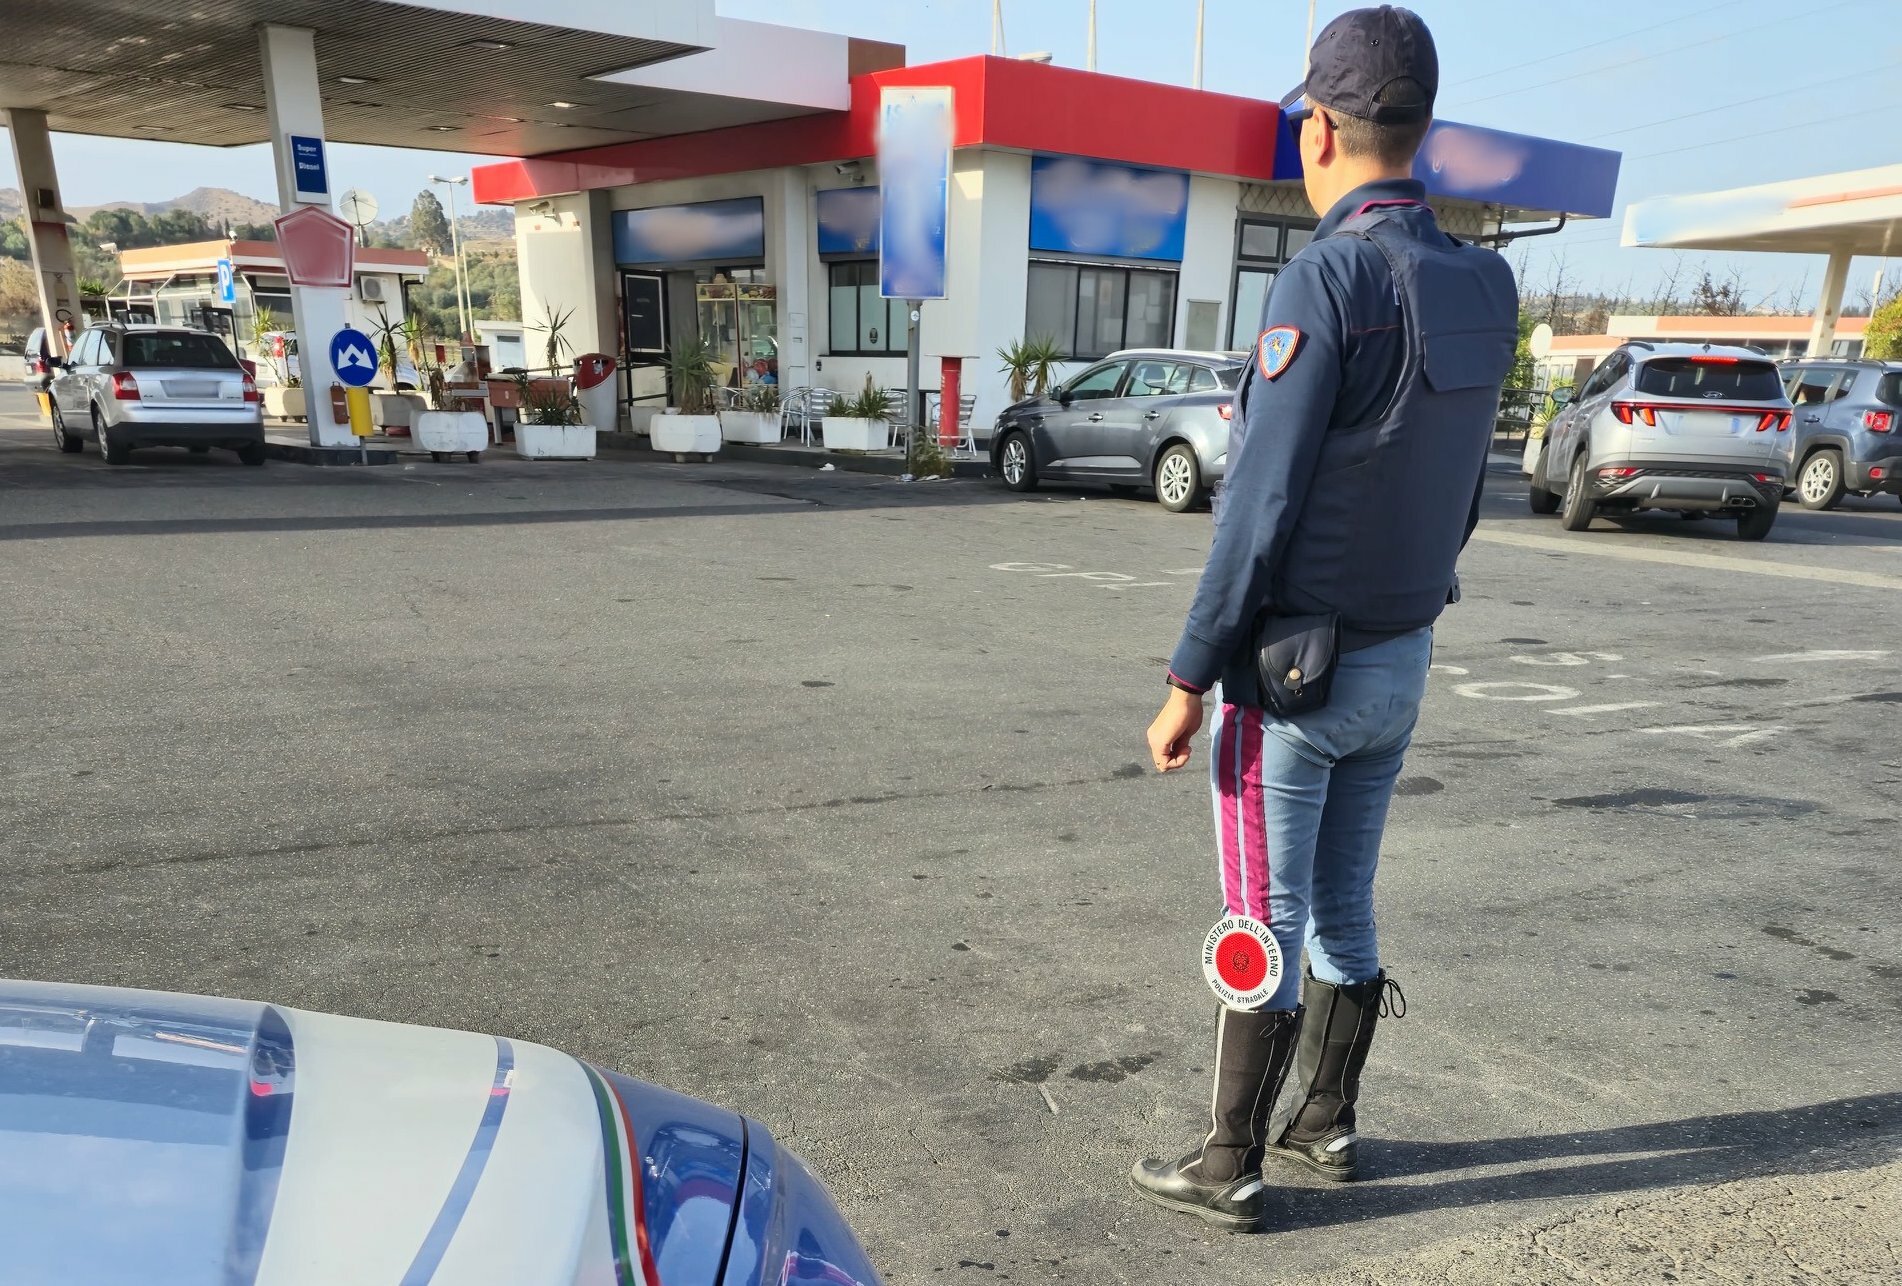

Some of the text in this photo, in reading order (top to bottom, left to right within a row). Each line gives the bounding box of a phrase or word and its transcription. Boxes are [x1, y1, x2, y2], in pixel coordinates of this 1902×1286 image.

[220, 264, 230, 297] P
[1204, 918, 1278, 977] MINISTERO DELL'INTERNO
[1212, 979, 1269, 1004] POLIZIA STRADALE
